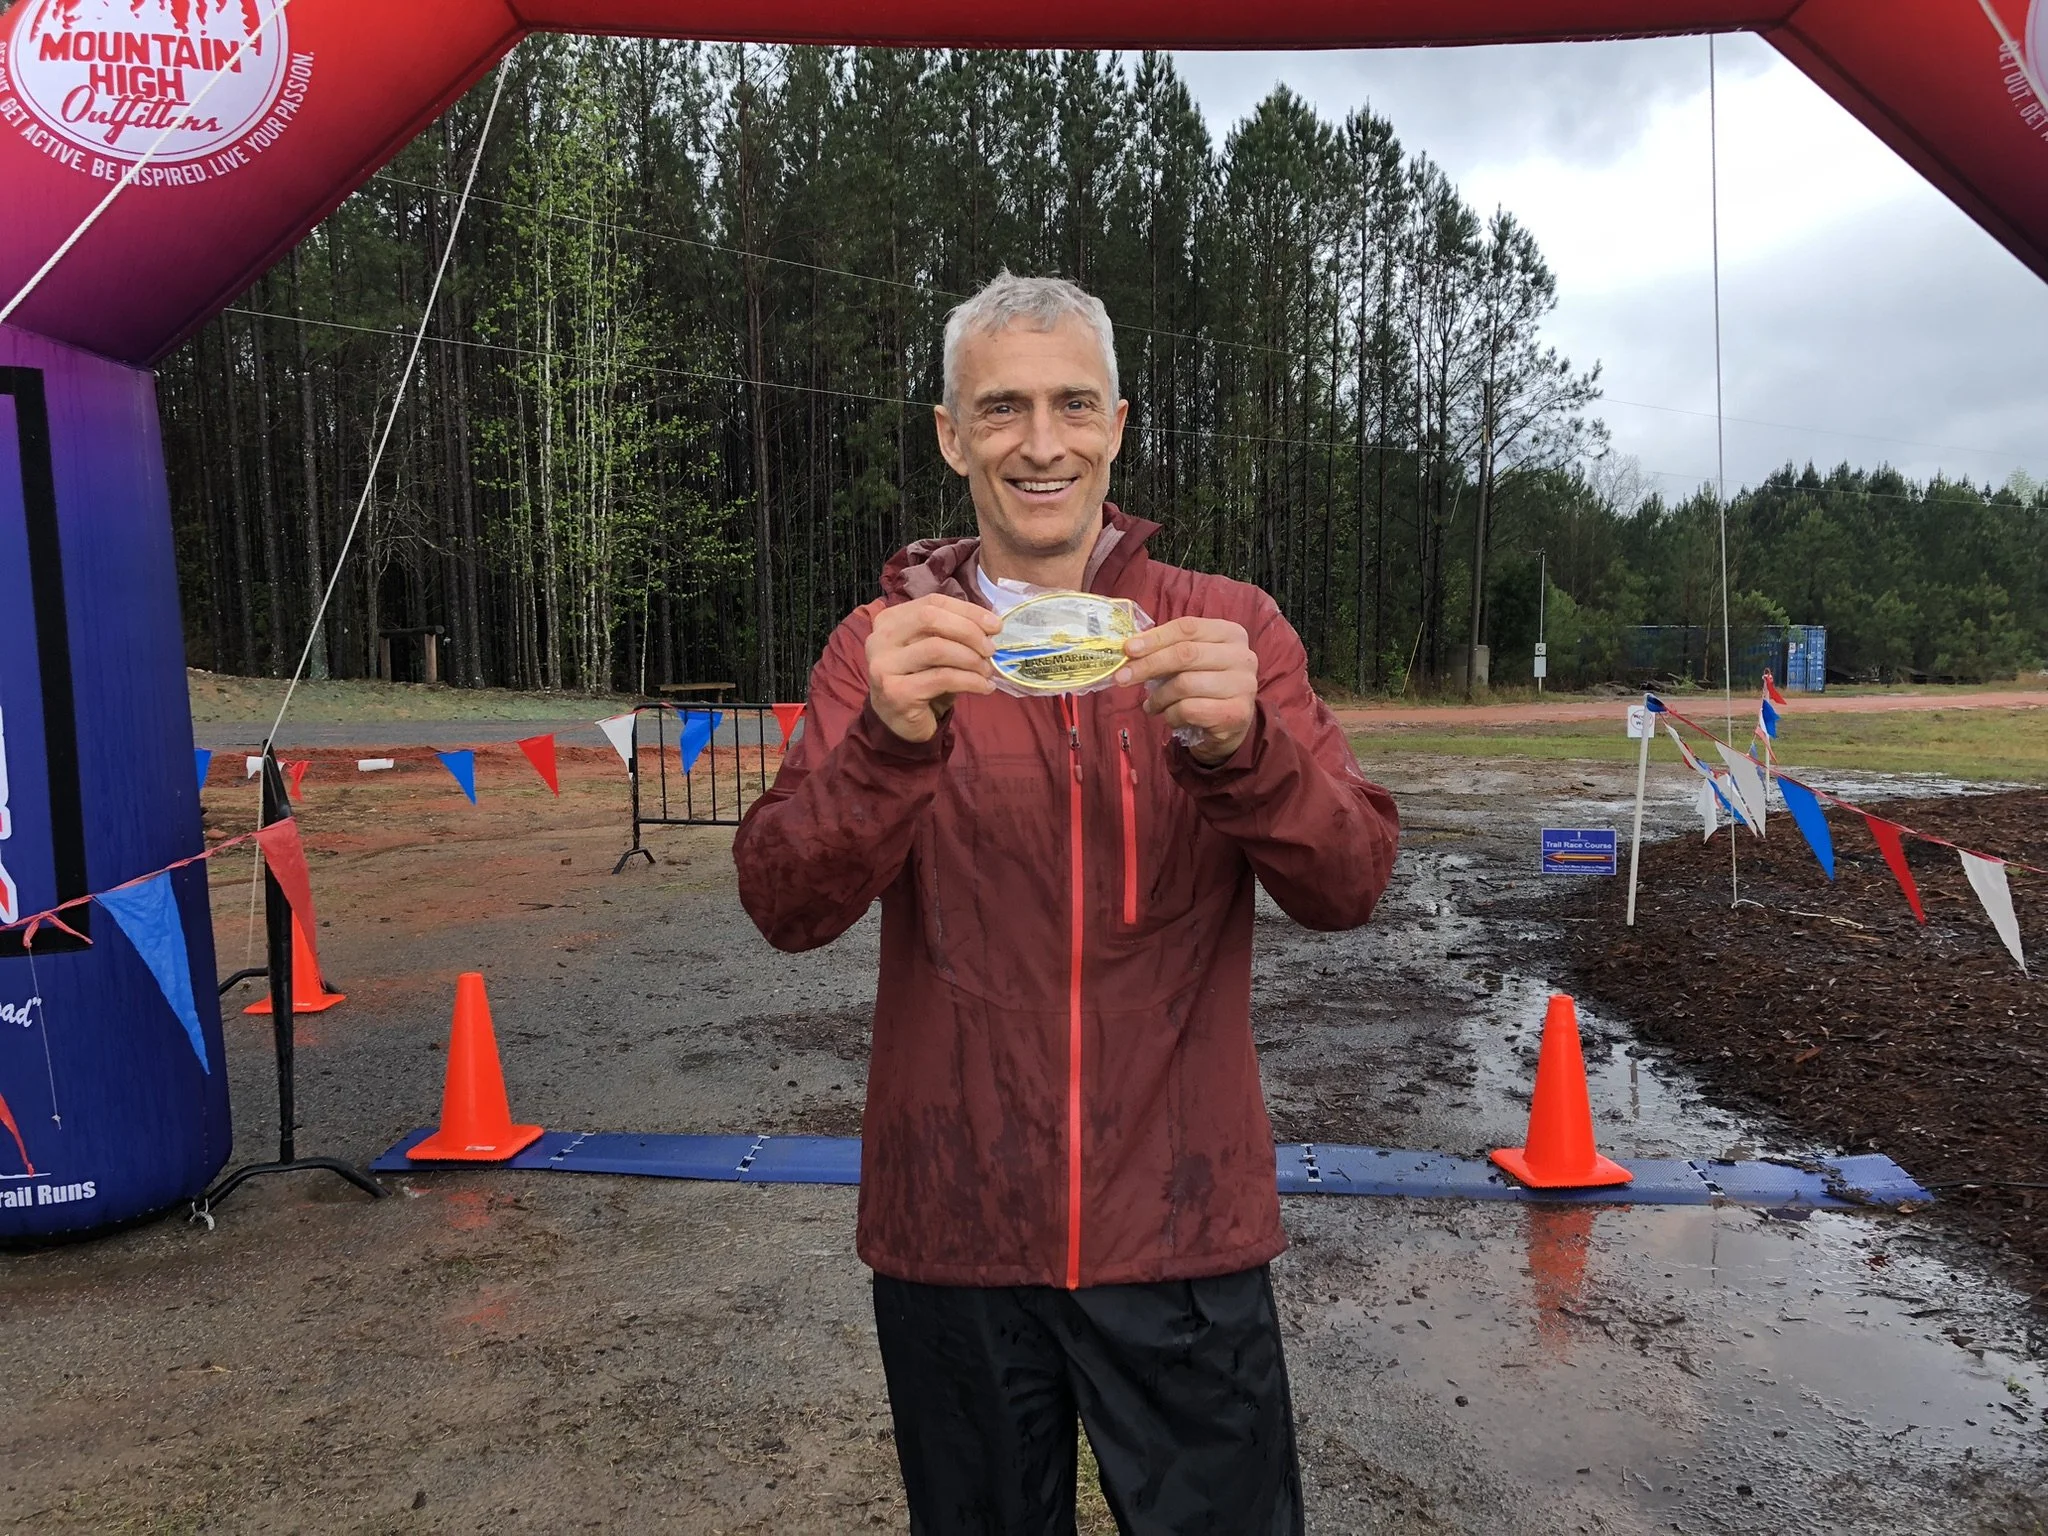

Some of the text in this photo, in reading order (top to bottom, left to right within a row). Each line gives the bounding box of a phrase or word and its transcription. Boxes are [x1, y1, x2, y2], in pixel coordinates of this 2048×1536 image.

[39, 31, 242, 73] MOUNTAIN
[89, 63, 185, 101] HIGH
[0, 50, 315, 187] GET ACTIVE. BE INSPIRED. LIVE YOUR PASSION.
[61, 84, 223, 145] Outfitters
[1563, 841, 1583, 849] Race
[0, 996, 42, 1028] ad"
[37, 1181, 97, 1205] Runs
